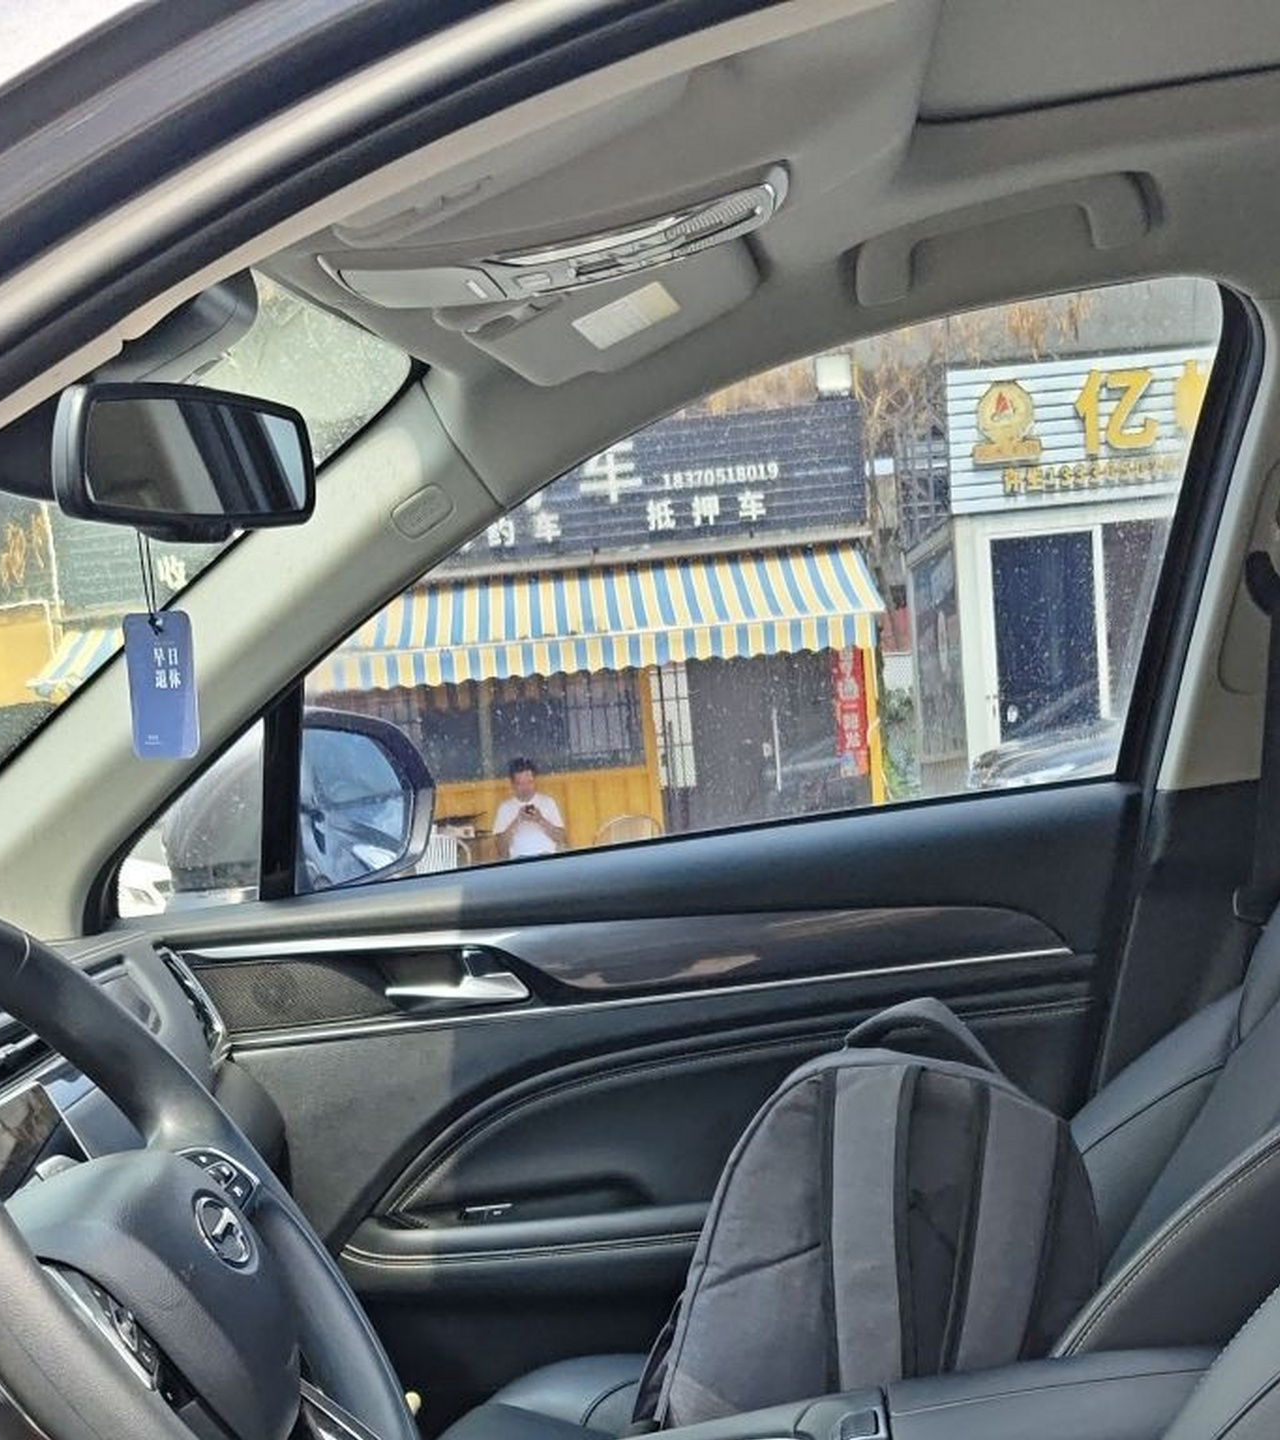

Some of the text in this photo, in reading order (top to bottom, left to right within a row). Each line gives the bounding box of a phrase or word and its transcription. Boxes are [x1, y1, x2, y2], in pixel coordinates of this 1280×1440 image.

[646, 490, 767, 531] 抵押车
[153, 647, 179, 667] 早日
[155, 669, 182, 689] 退休
